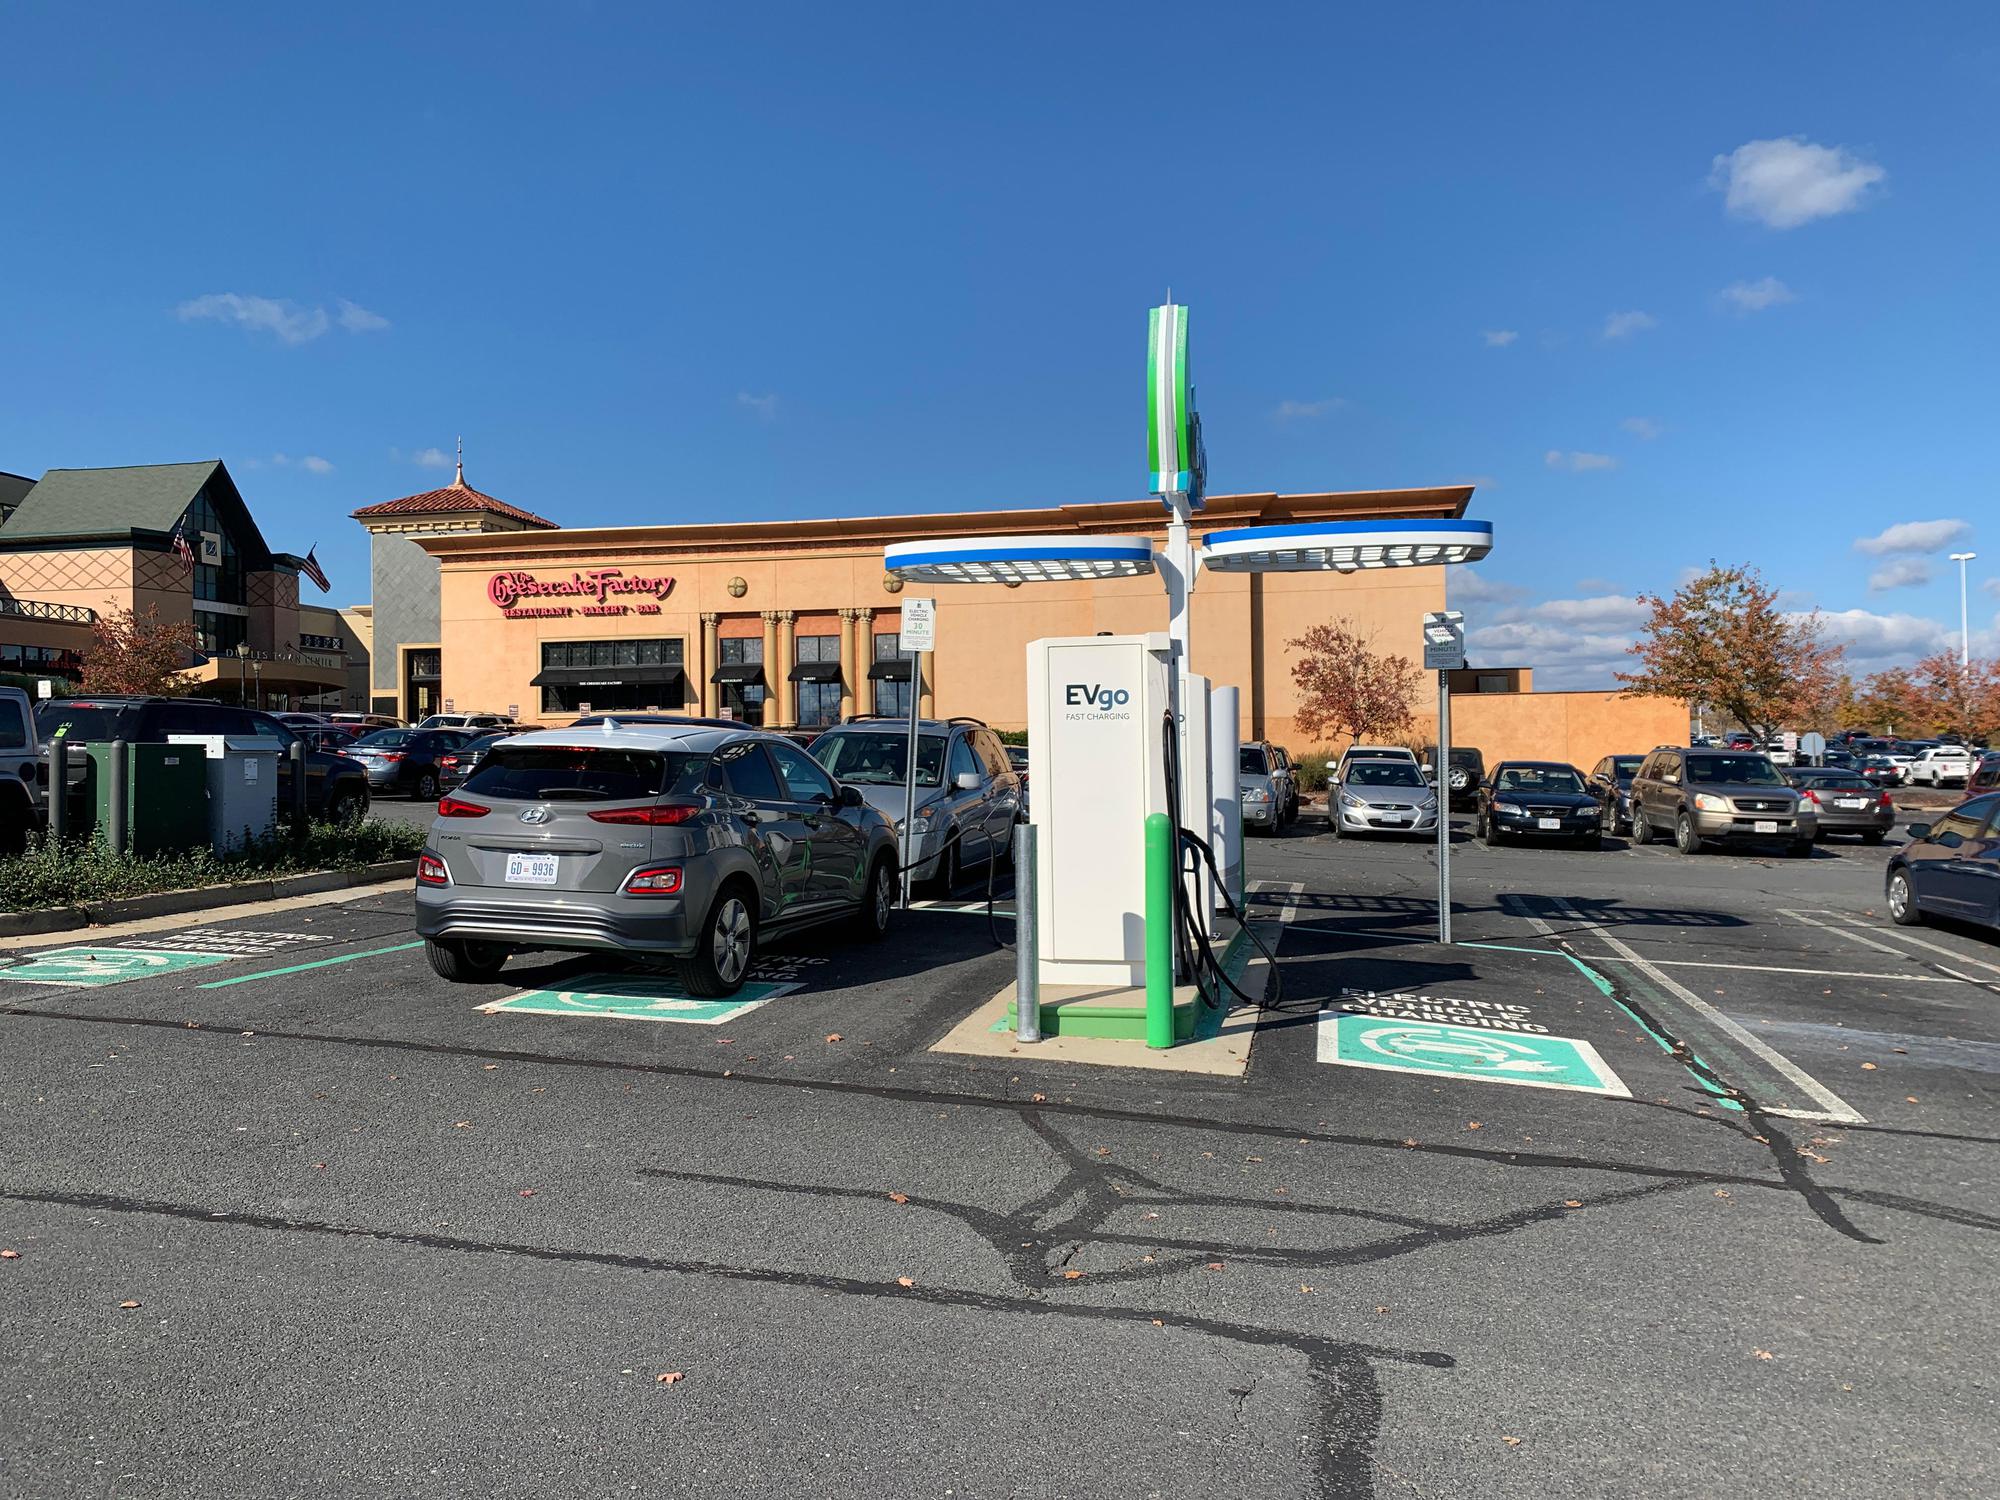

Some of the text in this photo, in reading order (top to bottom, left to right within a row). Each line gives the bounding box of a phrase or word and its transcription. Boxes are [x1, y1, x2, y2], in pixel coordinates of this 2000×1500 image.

[487, 568, 674, 607] Cheesecake Factory
[513, 572, 532, 581] The
[502, 604, 660, 617] RESTAURANT BAKERY BAR
[1065, 683, 1130, 711] EVgo
[1086, 712, 1130, 720] CHARGING
[510, 861, 554, 876] GD 9936
[1341, 987, 1532, 1014] ELECTRIC
[1353, 996, 1529, 1023] VEHICLE
[1342, 1004, 1550, 1033] CHARGING
